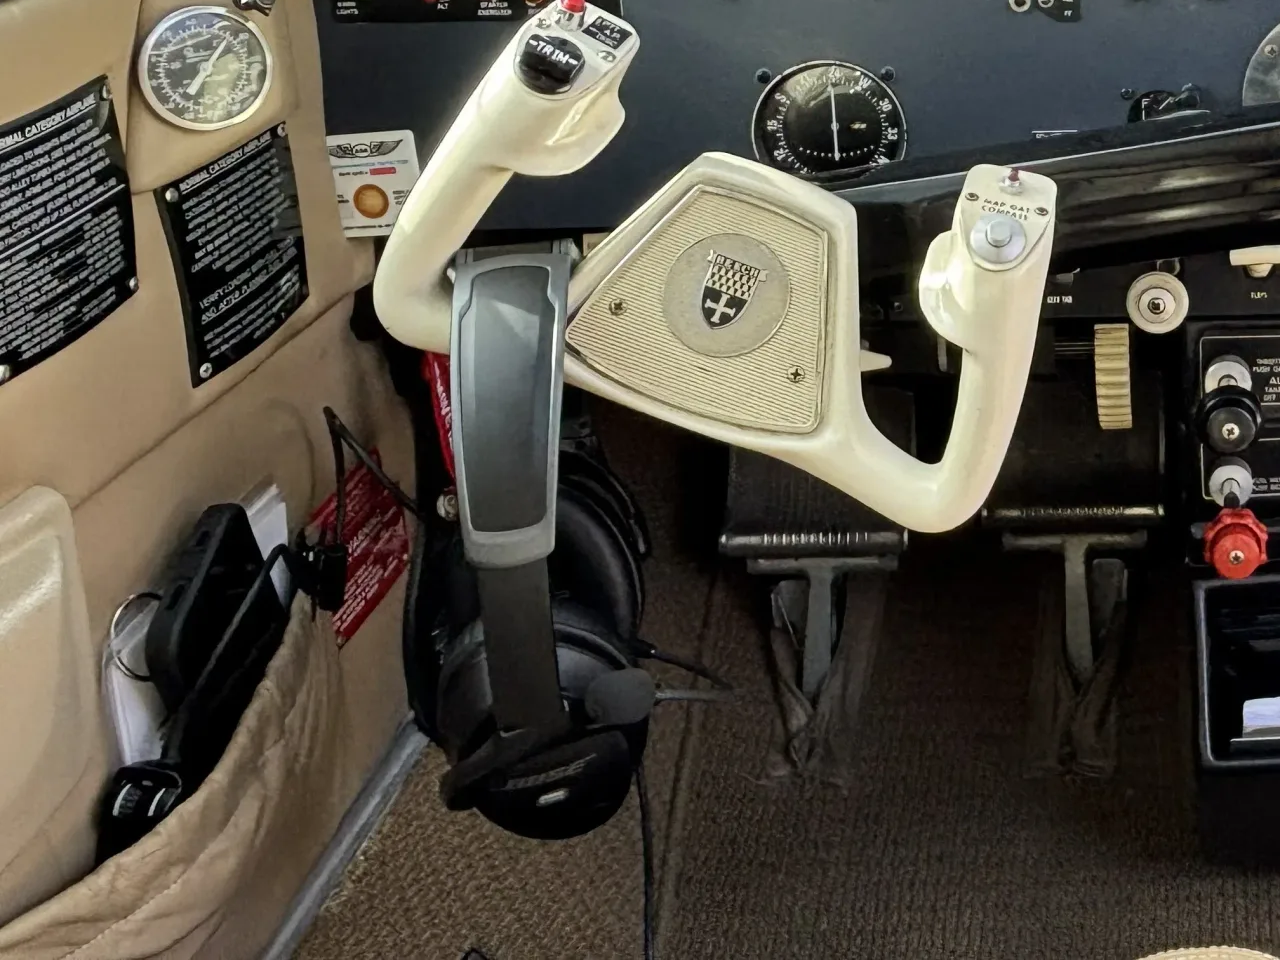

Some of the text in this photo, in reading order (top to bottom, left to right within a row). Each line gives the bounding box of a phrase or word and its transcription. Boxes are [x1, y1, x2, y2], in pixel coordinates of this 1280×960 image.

[536, 40, 570, 64] TRIM
[774, 92, 787, 103] S
[878, 97, 893, 112] 30
[25, 109, 66, 138] CATEGORY
[887, 127, 898, 141] 33
